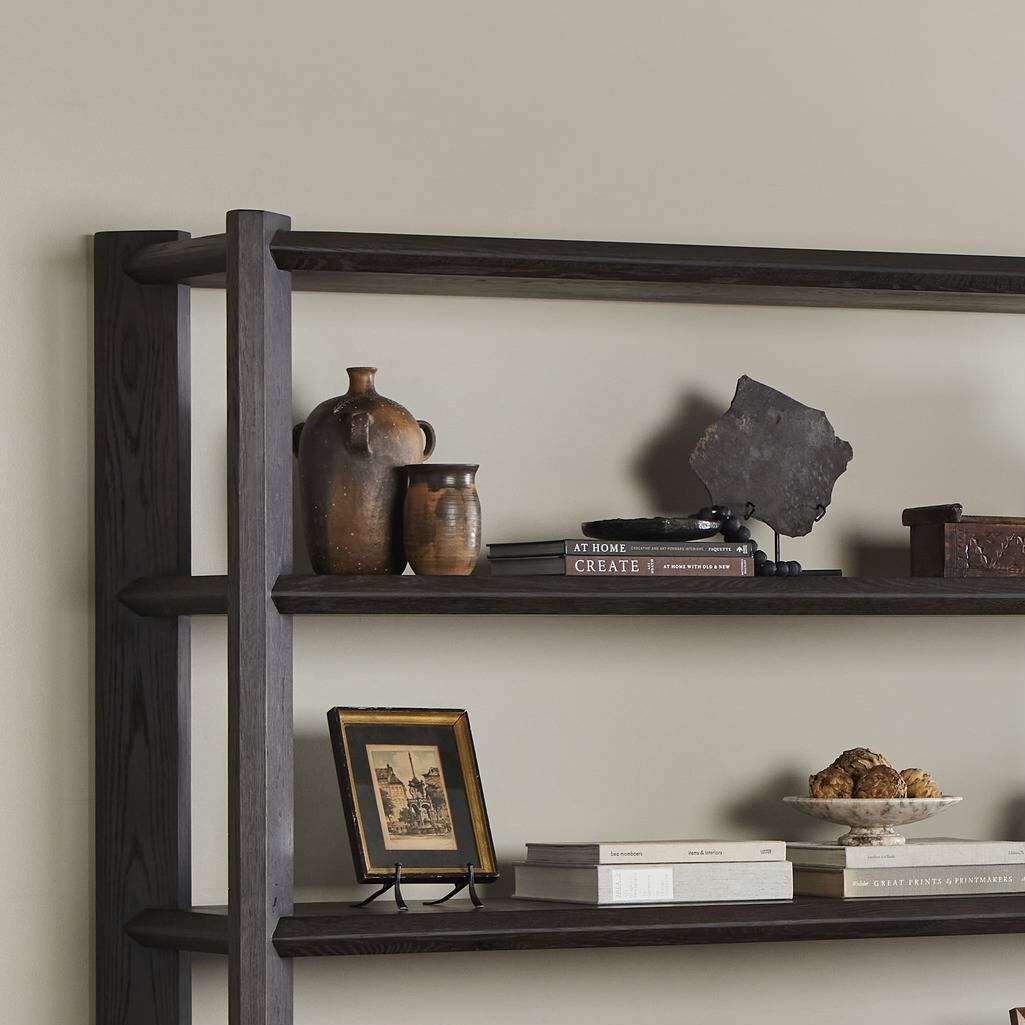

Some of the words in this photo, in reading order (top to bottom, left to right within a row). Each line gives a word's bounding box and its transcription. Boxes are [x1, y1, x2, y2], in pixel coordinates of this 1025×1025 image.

[574, 543, 588, 552] AT
[592, 543, 626, 553] HOME
[575, 559, 639, 572] CREATE
[873, 879, 904, 887] GREAT
[908, 878, 941, 886] PRINTS
